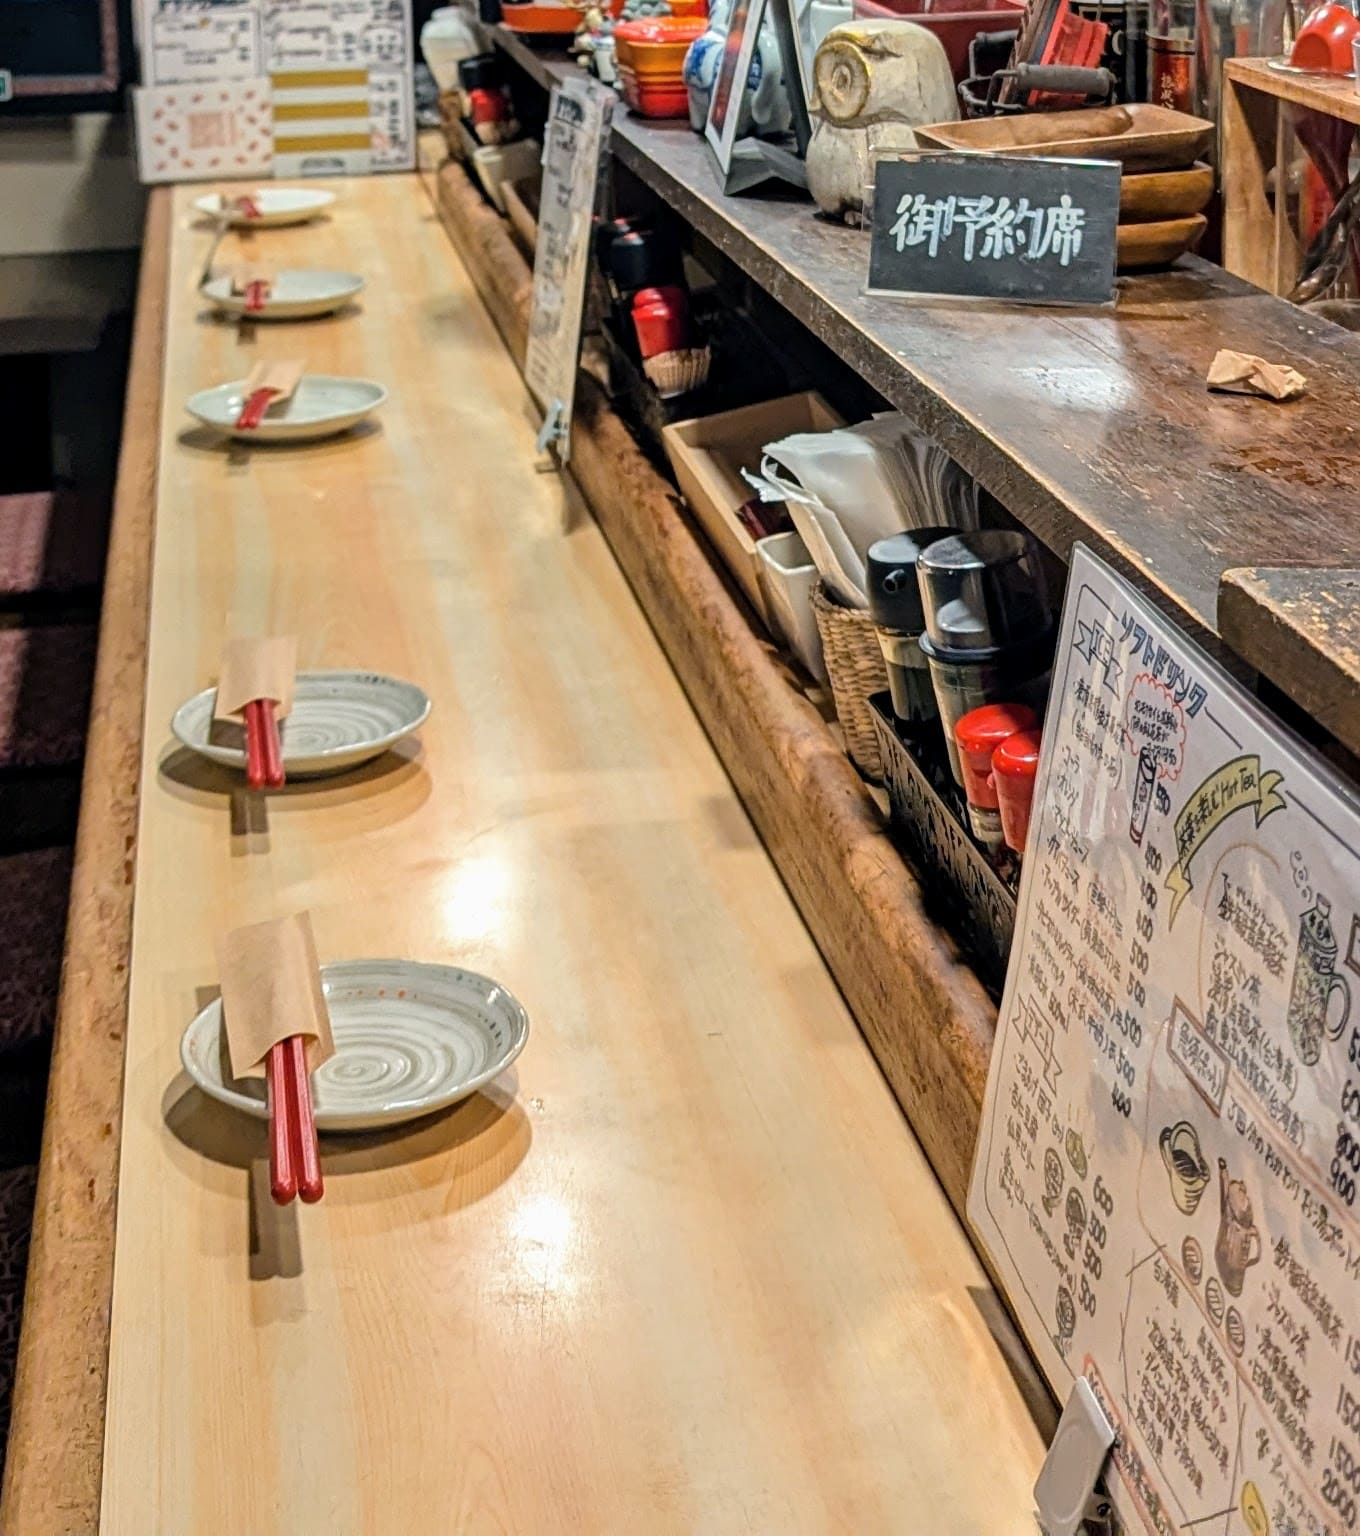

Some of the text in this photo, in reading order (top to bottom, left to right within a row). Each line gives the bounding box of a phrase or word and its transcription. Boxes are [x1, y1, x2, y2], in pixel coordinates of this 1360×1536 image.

[889, 193, 1086, 266] 御予約席
[1092, 627, 1110, 664] ICE
[1120, 610, 1208, 719] ソフトドリンク
[1239, 767, 1258, 794] Tea
[1128, 936, 1151, 979] 500
[1125, 969, 1147, 1010] 500
[1120, 1007, 1143, 1051] 500
[1115, 1046, 1136, 1090] 500
[1110, 1079, 1132, 1122] 400
[1010, 1080, 1108, 1252] 杏仁豆腐 500
[1327, 1154, 1358, 1210] 900
[1081, 1237, 1104, 1284] 500
[1076, 1271, 1098, 1320] 500
[1318, 1462, 1359, 1534] 2000
